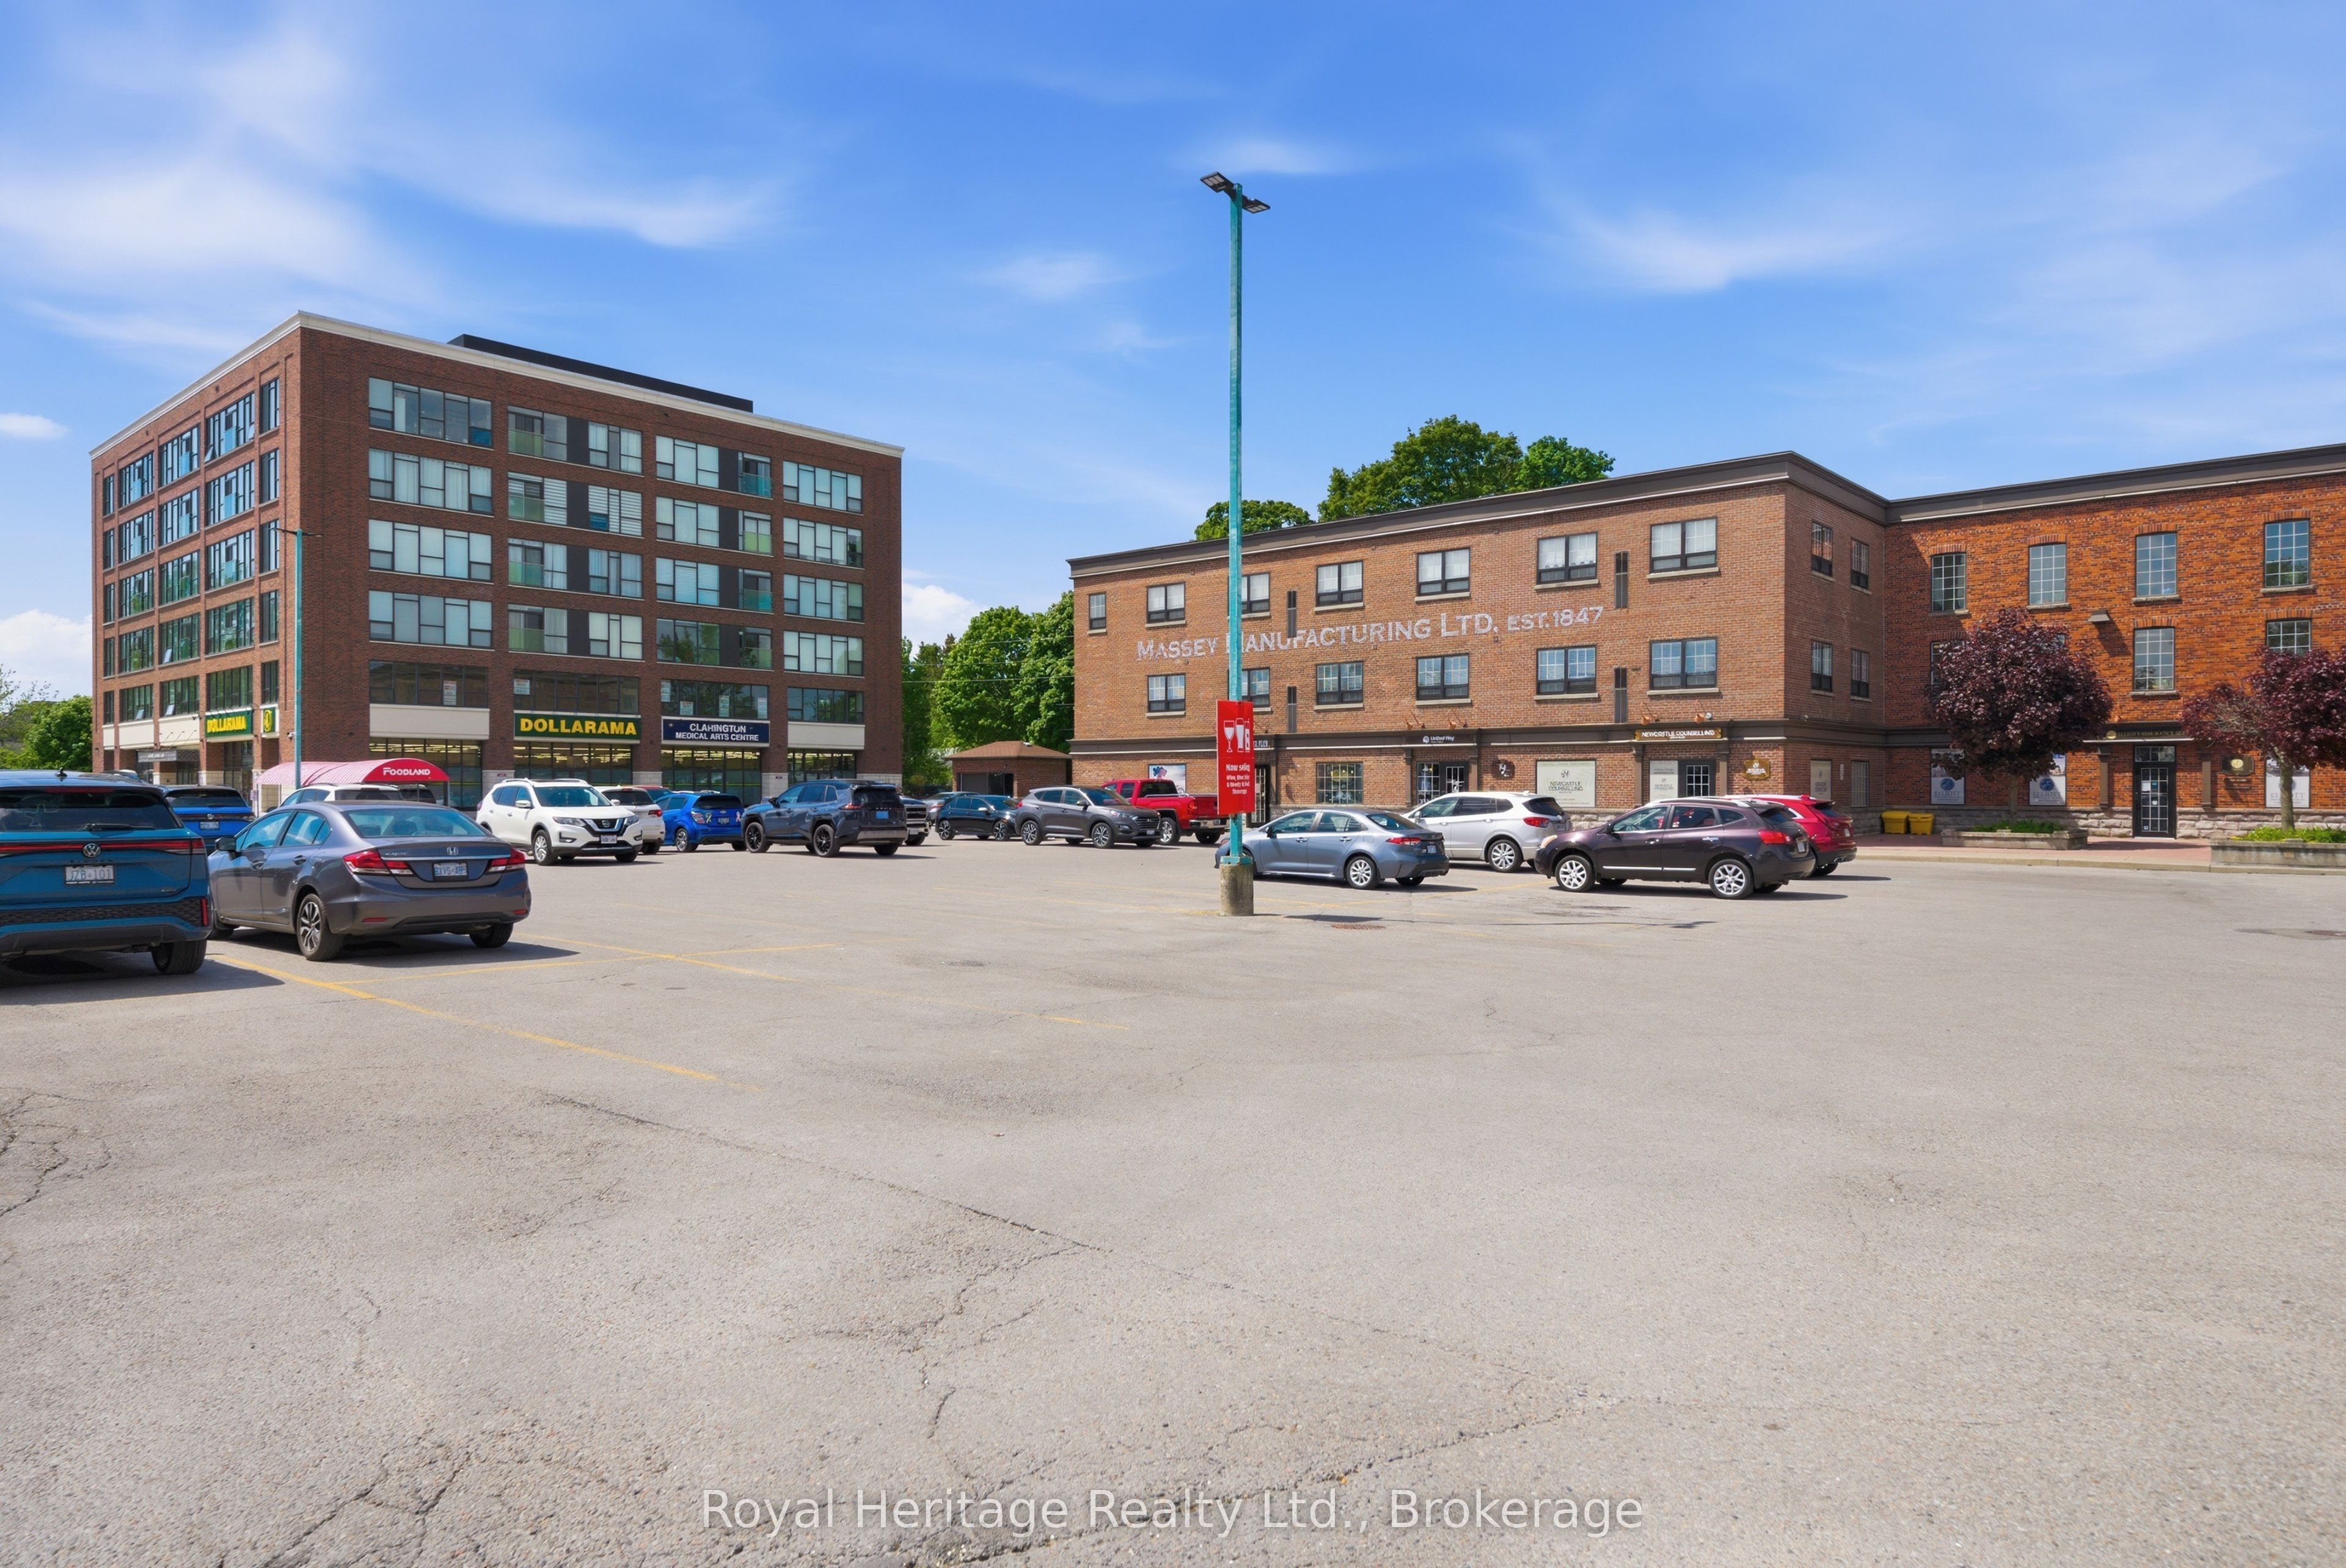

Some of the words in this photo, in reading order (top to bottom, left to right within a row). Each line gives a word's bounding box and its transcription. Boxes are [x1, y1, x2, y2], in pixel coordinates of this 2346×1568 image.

[1136, 637, 1219, 662] MASSEY
[1441, 613, 1498, 637] LTD.
[1507, 613, 1549, 631] EST.
[1552, 606, 1603, 627] 1847
[520, 718, 637, 735] DOLLARAMA
[383, 767, 431, 776] FOODLAND
